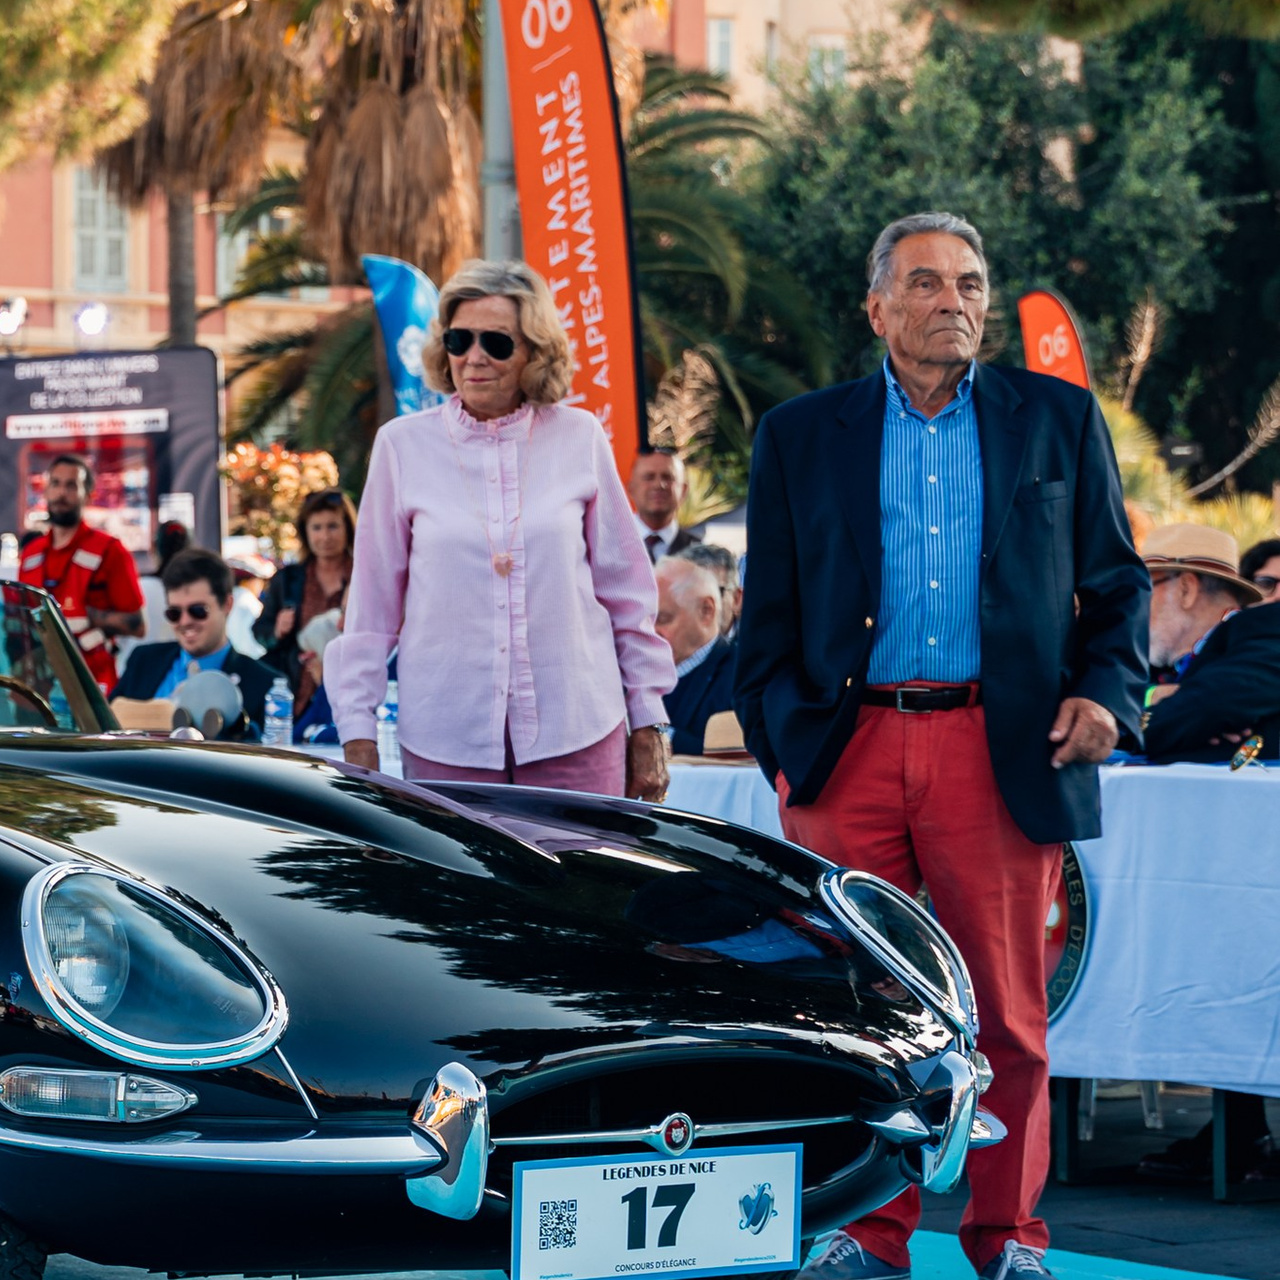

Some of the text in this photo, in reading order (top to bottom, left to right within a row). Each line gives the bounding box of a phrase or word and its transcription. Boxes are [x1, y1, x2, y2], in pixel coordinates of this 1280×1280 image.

[1038, 323, 1069, 367] 06
[603, 1161, 717, 1181] LEGENDES DE NICE
[621, 1183, 696, 1250] 17
[615, 1261, 655, 1272] CONCOURS
